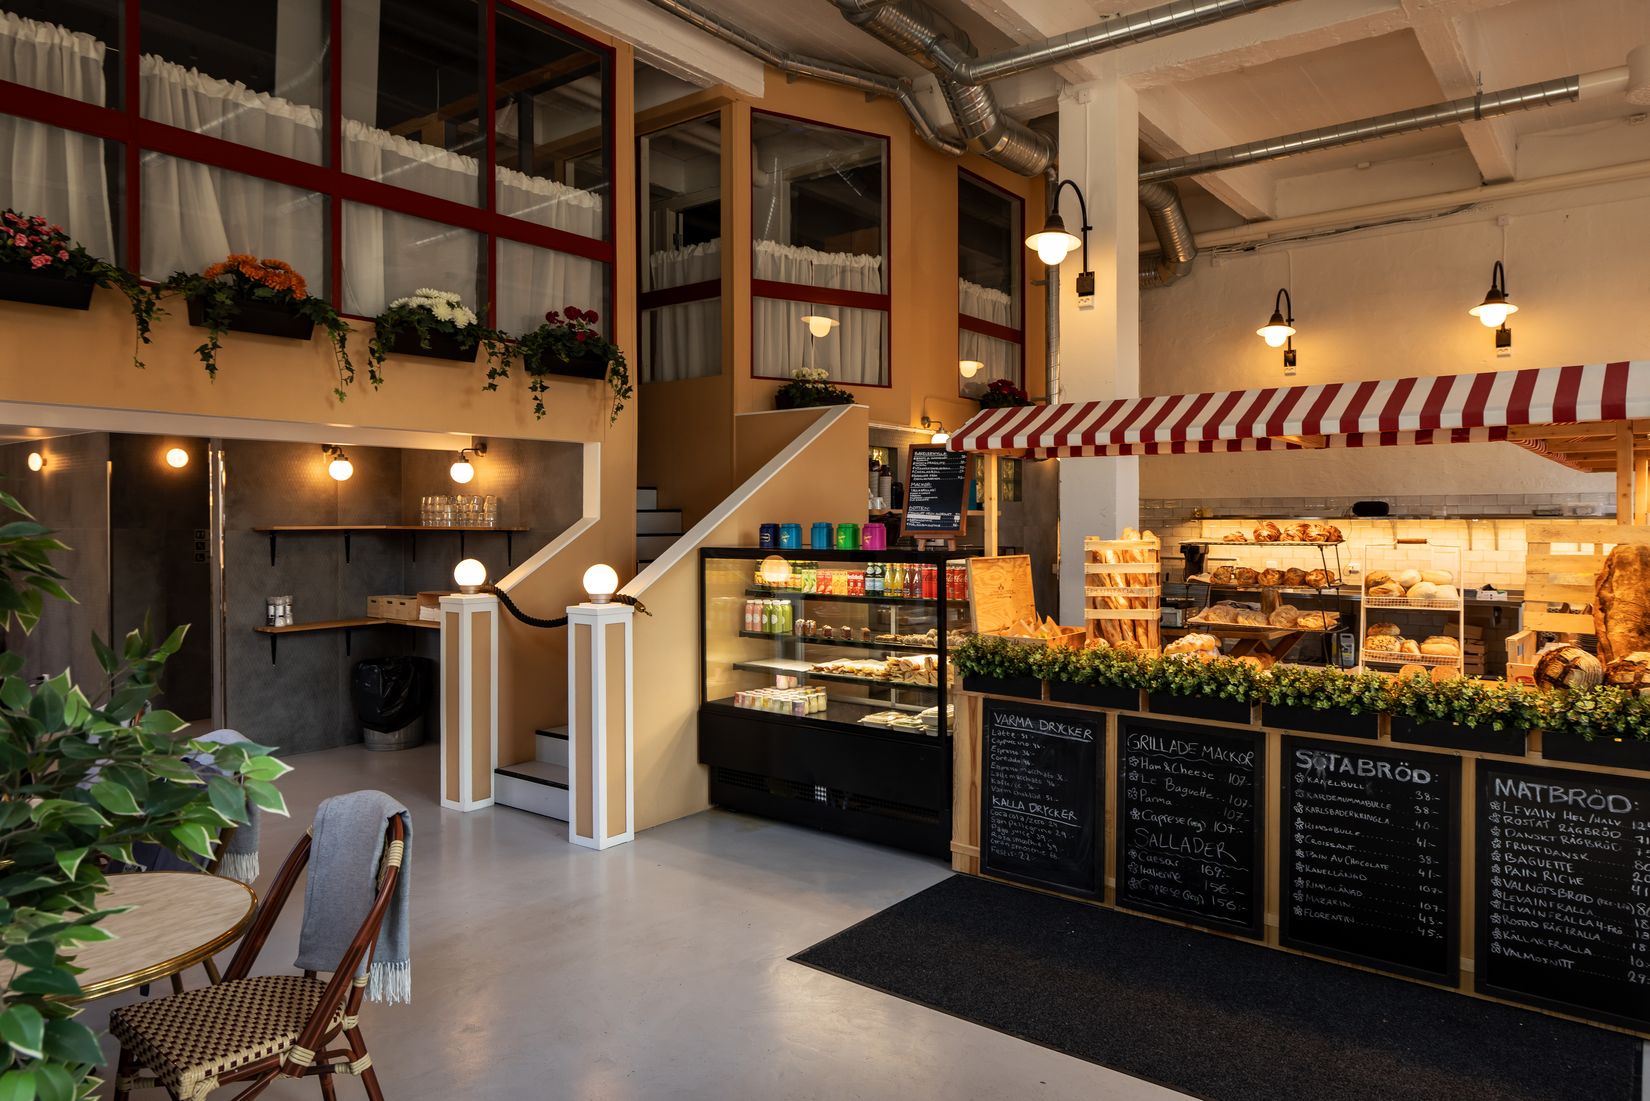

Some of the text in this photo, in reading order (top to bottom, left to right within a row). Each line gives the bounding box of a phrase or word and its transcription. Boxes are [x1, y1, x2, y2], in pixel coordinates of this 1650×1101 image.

[991, 729, 1016, 739] Latte
[994, 712, 1093, 740] VARMA DRYCKER
[1127, 733, 1255, 768] GRILLADE MACKOR
[1141, 774, 1157, 785] Le
[1140, 788, 1173, 806] Parma
[992, 795, 1078, 821] KALLA DRYCKER
[1502, 800, 1556, 821] LEVAIN
[1502, 815, 1551, 831] ROSTAT
[1504, 828, 1557, 844] DANSKT
[1135, 827, 1238, 863] SALLADER
[1138, 851, 1180, 867] Caesar
[1305, 850, 1327, 860] PAIN
[1504, 854, 1574, 874] BAGUETTE
[1504, 865, 1537, 881] PAIN
[1542, 872, 1585, 887] RICHE
[1305, 893, 1352, 908] MAZARIN
[1303, 908, 1355, 924] FLORENTIN
